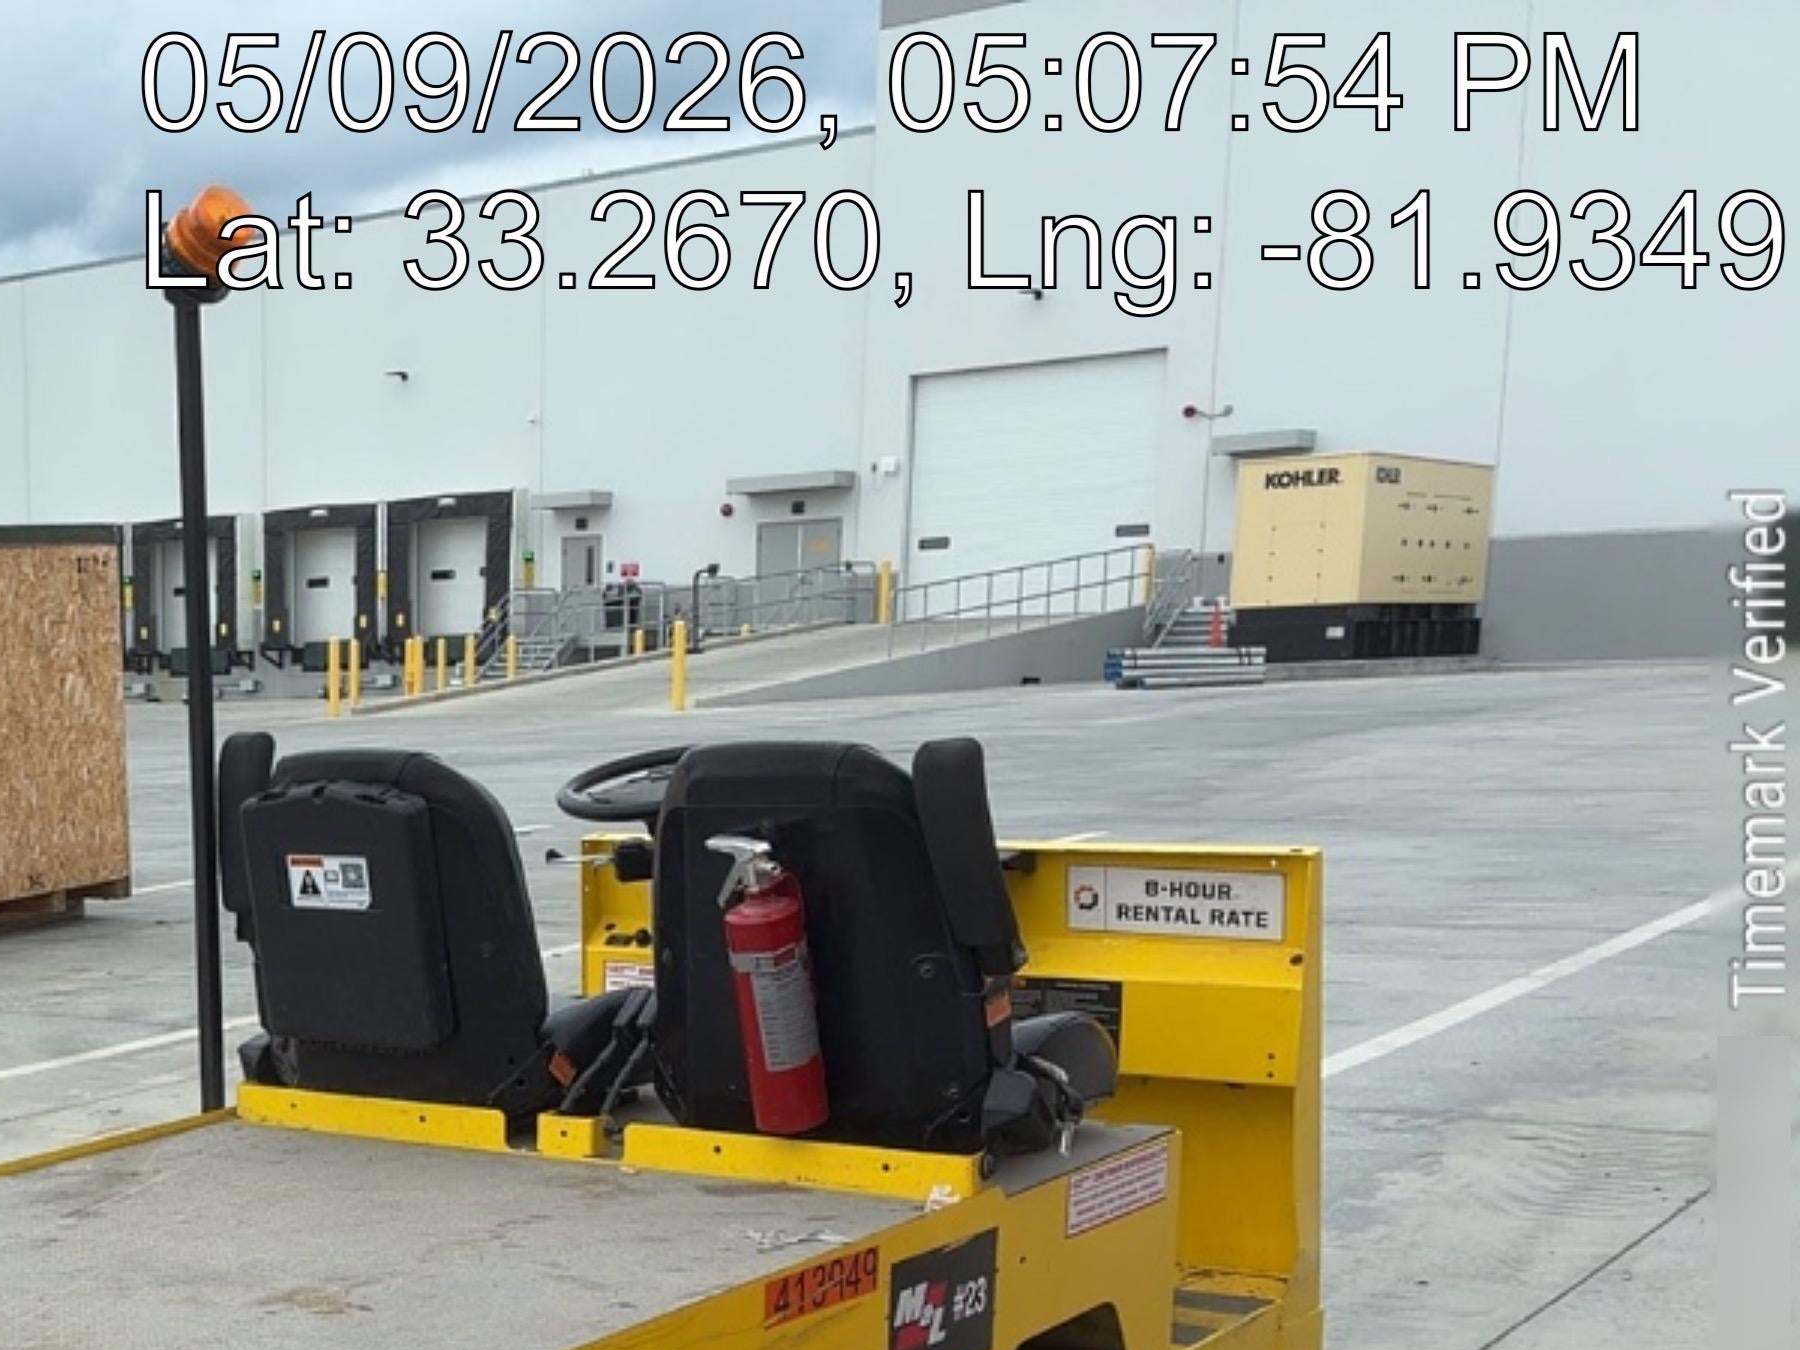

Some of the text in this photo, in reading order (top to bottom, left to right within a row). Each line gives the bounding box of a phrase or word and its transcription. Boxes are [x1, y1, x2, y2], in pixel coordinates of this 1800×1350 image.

[1264, 467, 1341, 490] KOHLER
[1144, 879, 1232, 901] 8-HOUR
[1115, 903, 1270, 929] RENTAL RATE
[772, 1247, 879, 1314] 413949
[952, 1275, 989, 1322] #23
